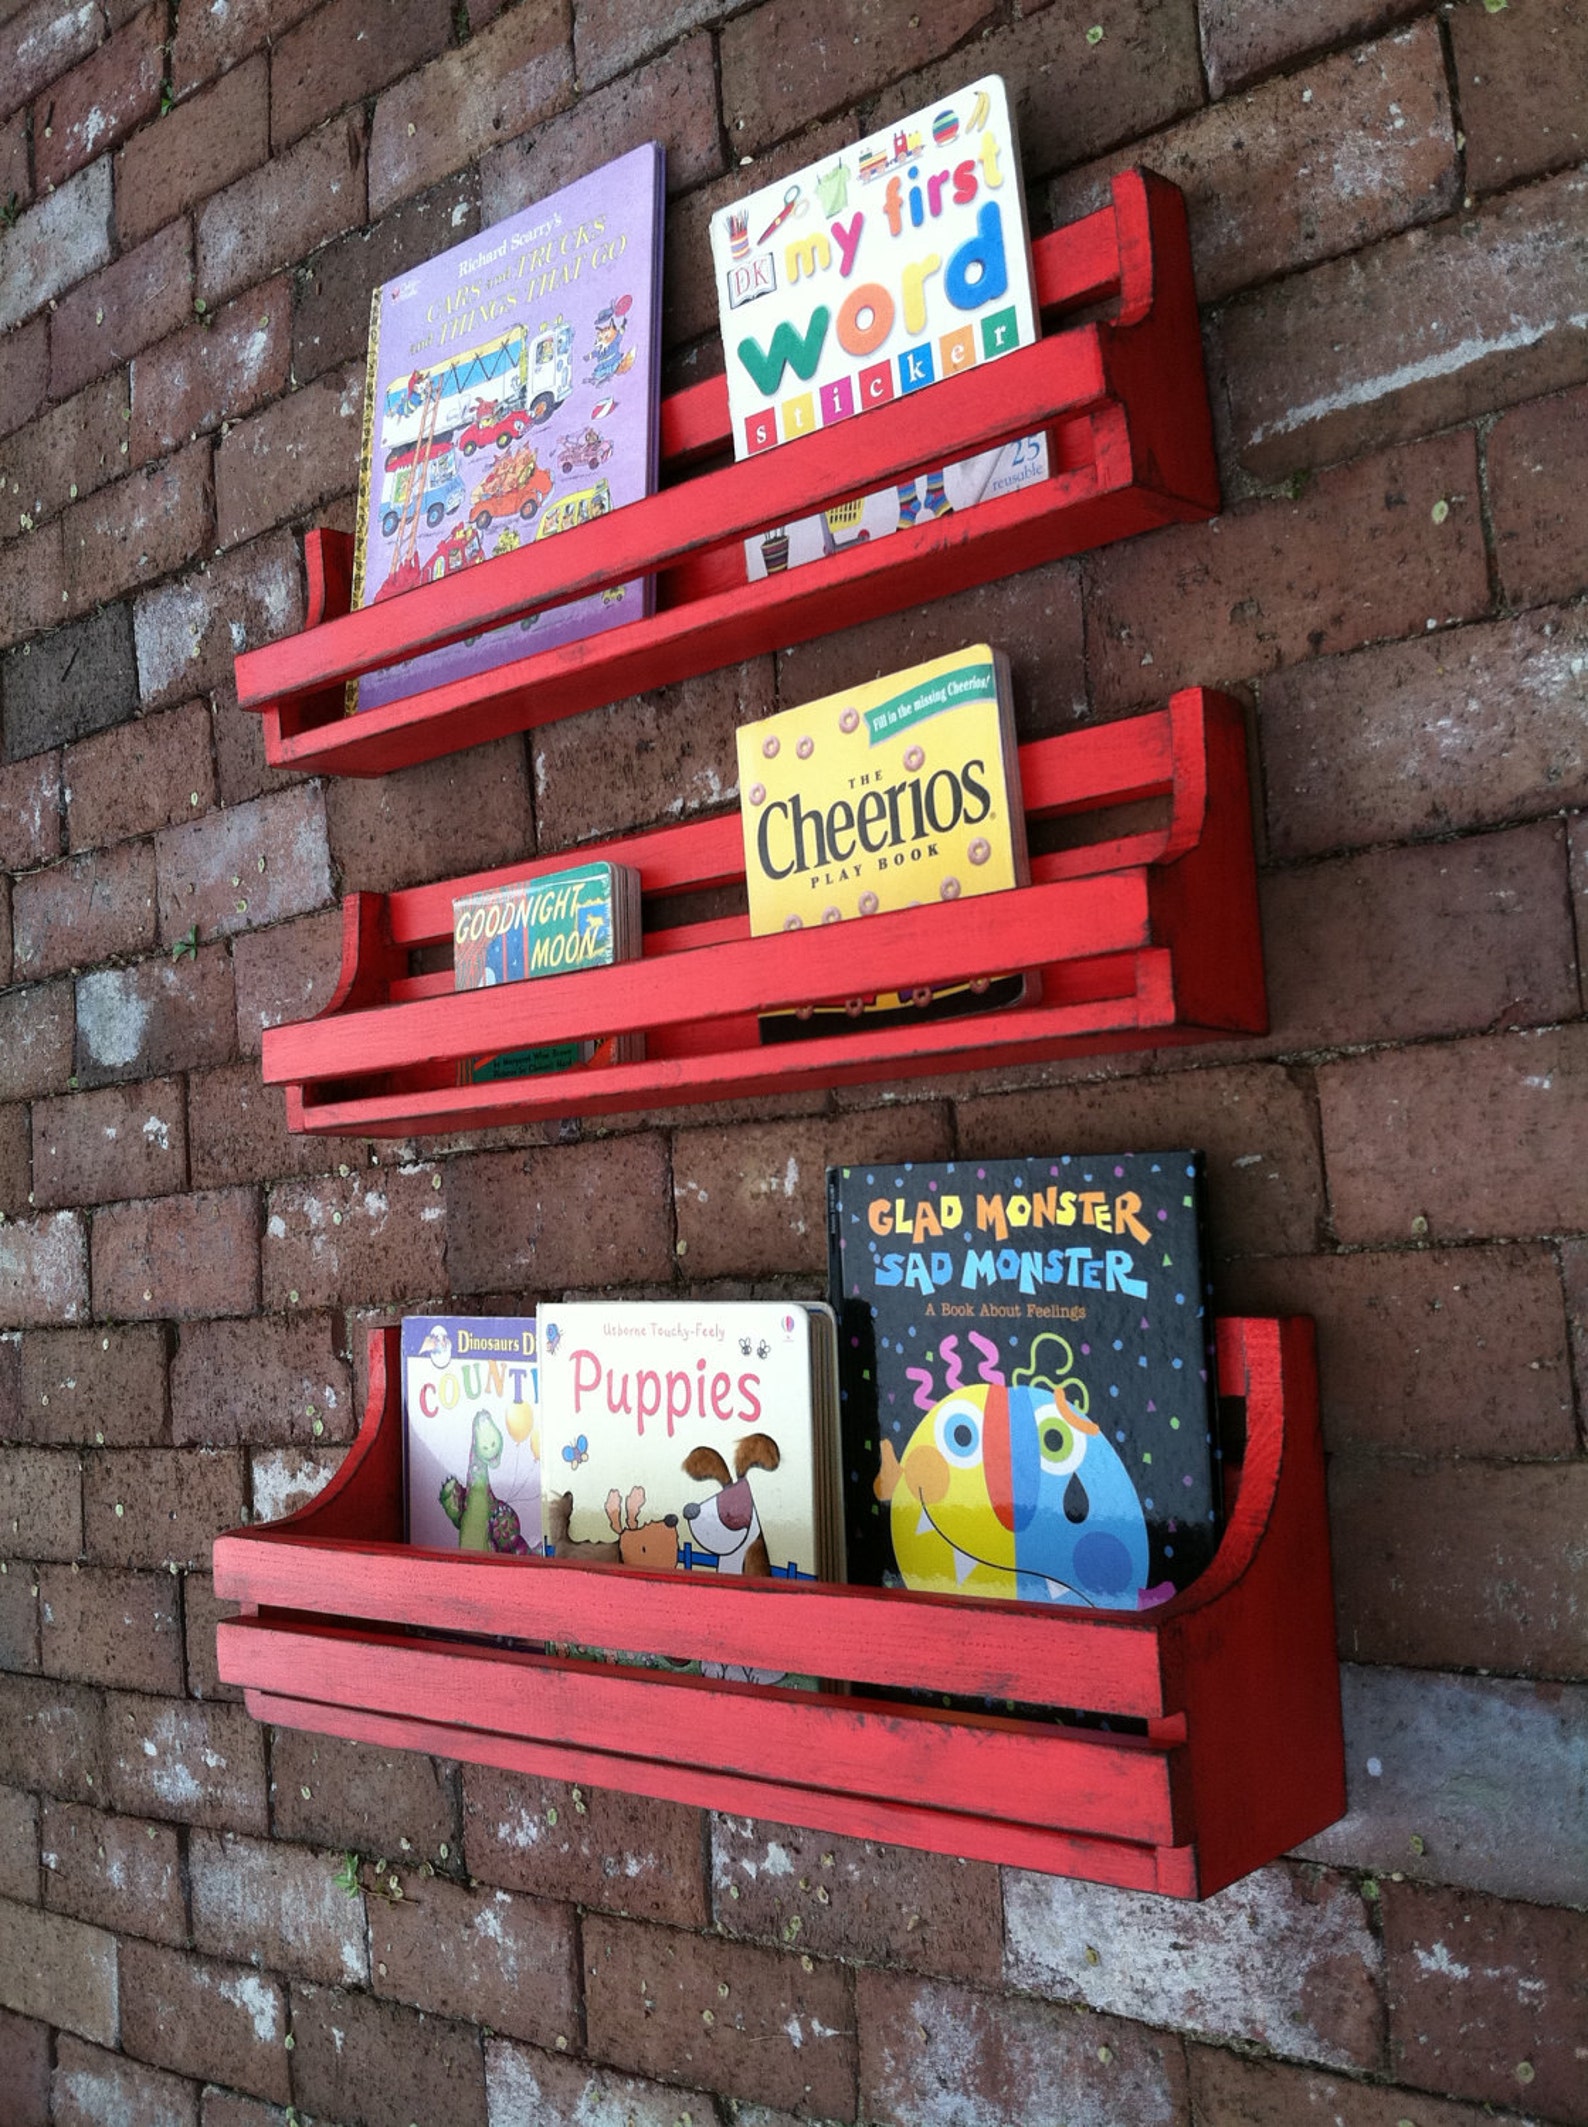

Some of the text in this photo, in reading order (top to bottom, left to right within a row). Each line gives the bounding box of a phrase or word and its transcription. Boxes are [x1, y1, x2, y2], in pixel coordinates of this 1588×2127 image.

[784, 131, 1003, 284] my first
[427, 280, 482, 325] CARS
[517, 214, 607, 278] TRUCKS
[458, 212, 562, 278] Richard Scarry's
[439, 289, 518, 346] THINGS
[528, 252, 589, 303] THAT
[591, 234, 628, 269] GO
[733, 258, 770, 298] DK
[737, 201, 1008, 396] word
[754, 323, 1008, 445] sticker
[993, 461, 1044, 491] reusable
[1011, 435, 1040, 467] 25
[872, 674, 991, 733] Fill in the missing Cheerios!
[848, 770, 883, 789] THE
[810, 844, 940, 889] PLAY BOOK
[456, 882, 586, 944] GOODNIGHT
[531, 927, 599, 971] MOON
[868, 1195, 963, 1244] GLAD
[976, 1186, 1152, 1245] MONSTER
[875, 1247, 1148, 1300] SAD MONSTER
[603, 1322, 725, 1341] Usborne Touchy-Feely
[925, 1302, 1087, 1321] A Book About Feelings
[458, 1330, 537, 1356] Dinosaurs D
[570, 1349, 762, 1438] Puppies
